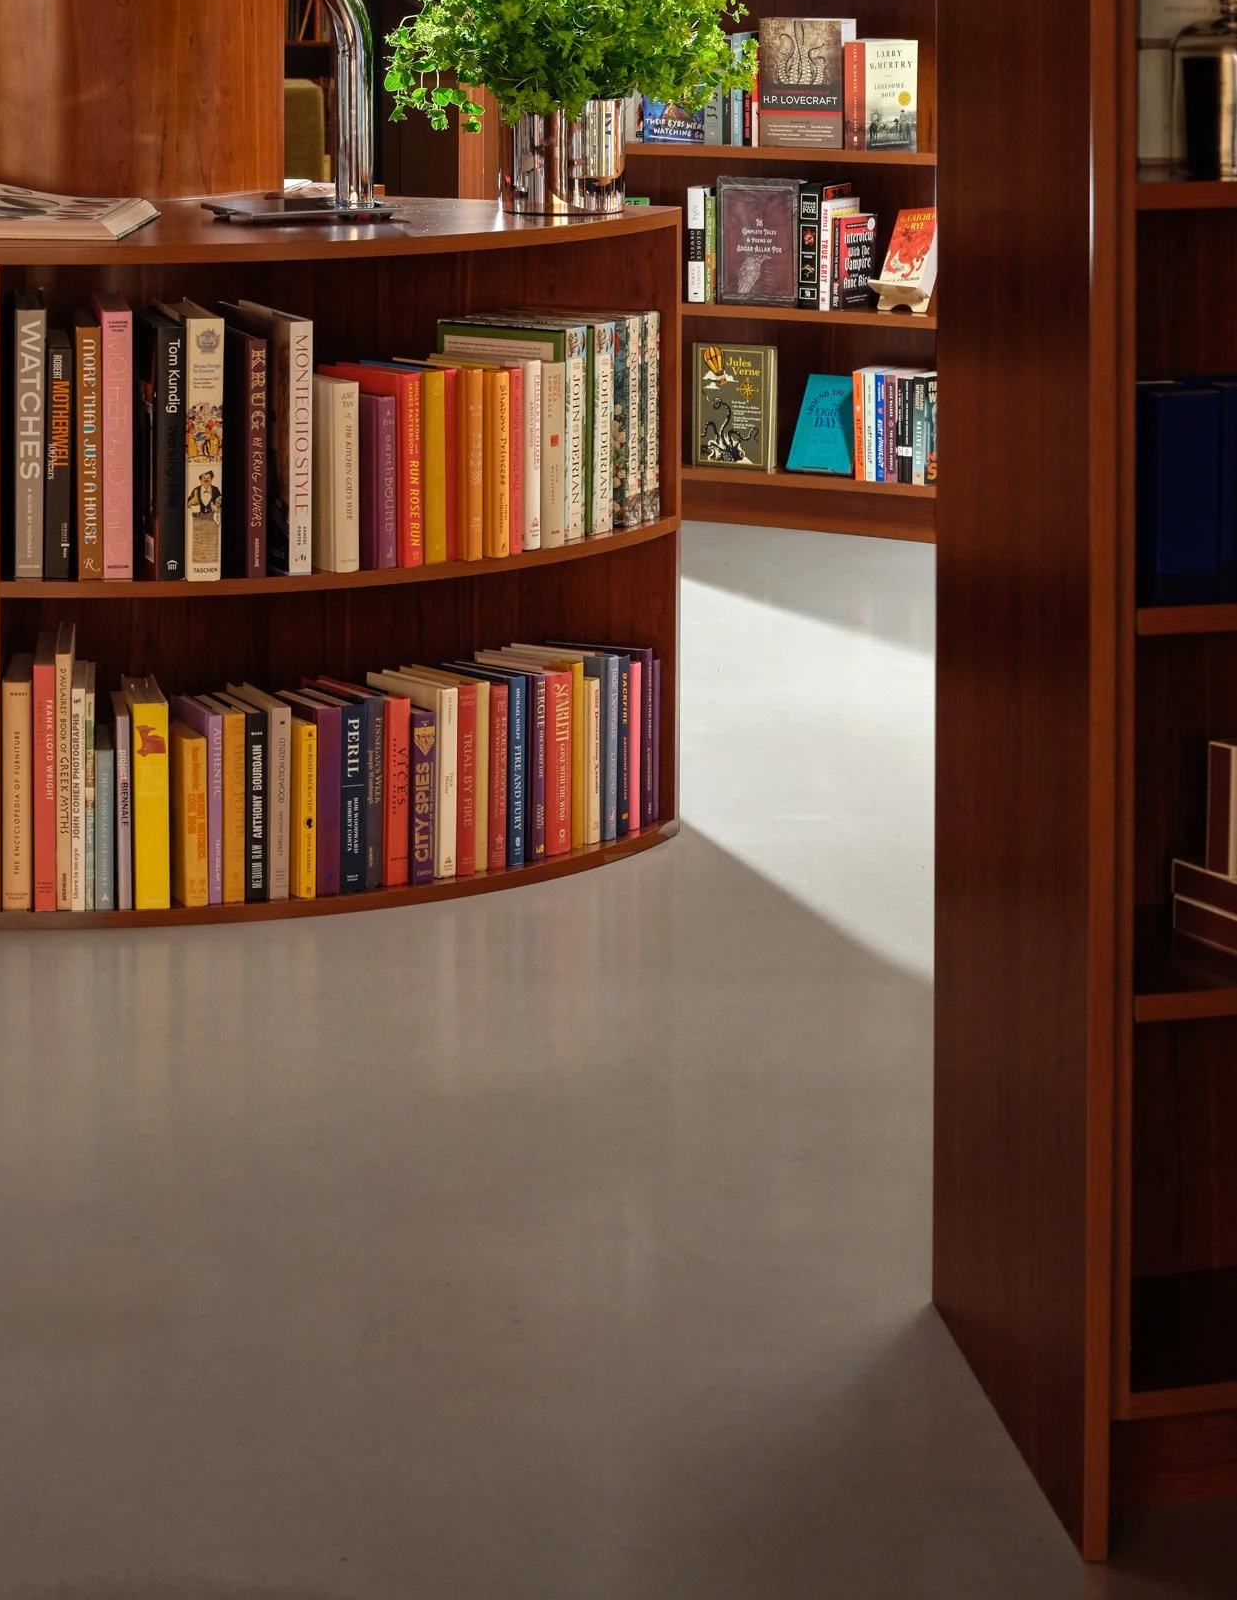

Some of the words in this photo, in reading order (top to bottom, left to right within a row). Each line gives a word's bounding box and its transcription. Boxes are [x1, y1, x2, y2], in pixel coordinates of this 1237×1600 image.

[764, 96, 778, 104] H.P.
[781, 96, 837, 105] LOVECRAFT
[168, 338, 180, 364] Tom
[727, 358, 752, 368] Jules
[732, 368, 760, 377] Verne
[20, 320, 41, 480] WATCHES
[166, 368, 180, 414] Kundig
[294, 334, 310, 453] MONTECITO
[572, 375, 580, 421] JOHN
[84, 440, 96, 480] JUST
[409, 460, 420, 485] RUN
[571, 435, 580, 504] DERIAN
[84, 484, 96, 494] A
[294, 456, 309, 516] STYLE
[409, 487, 420, 519] ROSE
[409, 522, 420, 546] RUN
[253, 744, 263, 790] BOURDAIN
[348, 718, 360, 778] PERIL
[415, 762, 430, 814] SPIES
[252, 792, 263, 838] ANTHONY
[415, 818, 429, 862] CITY
